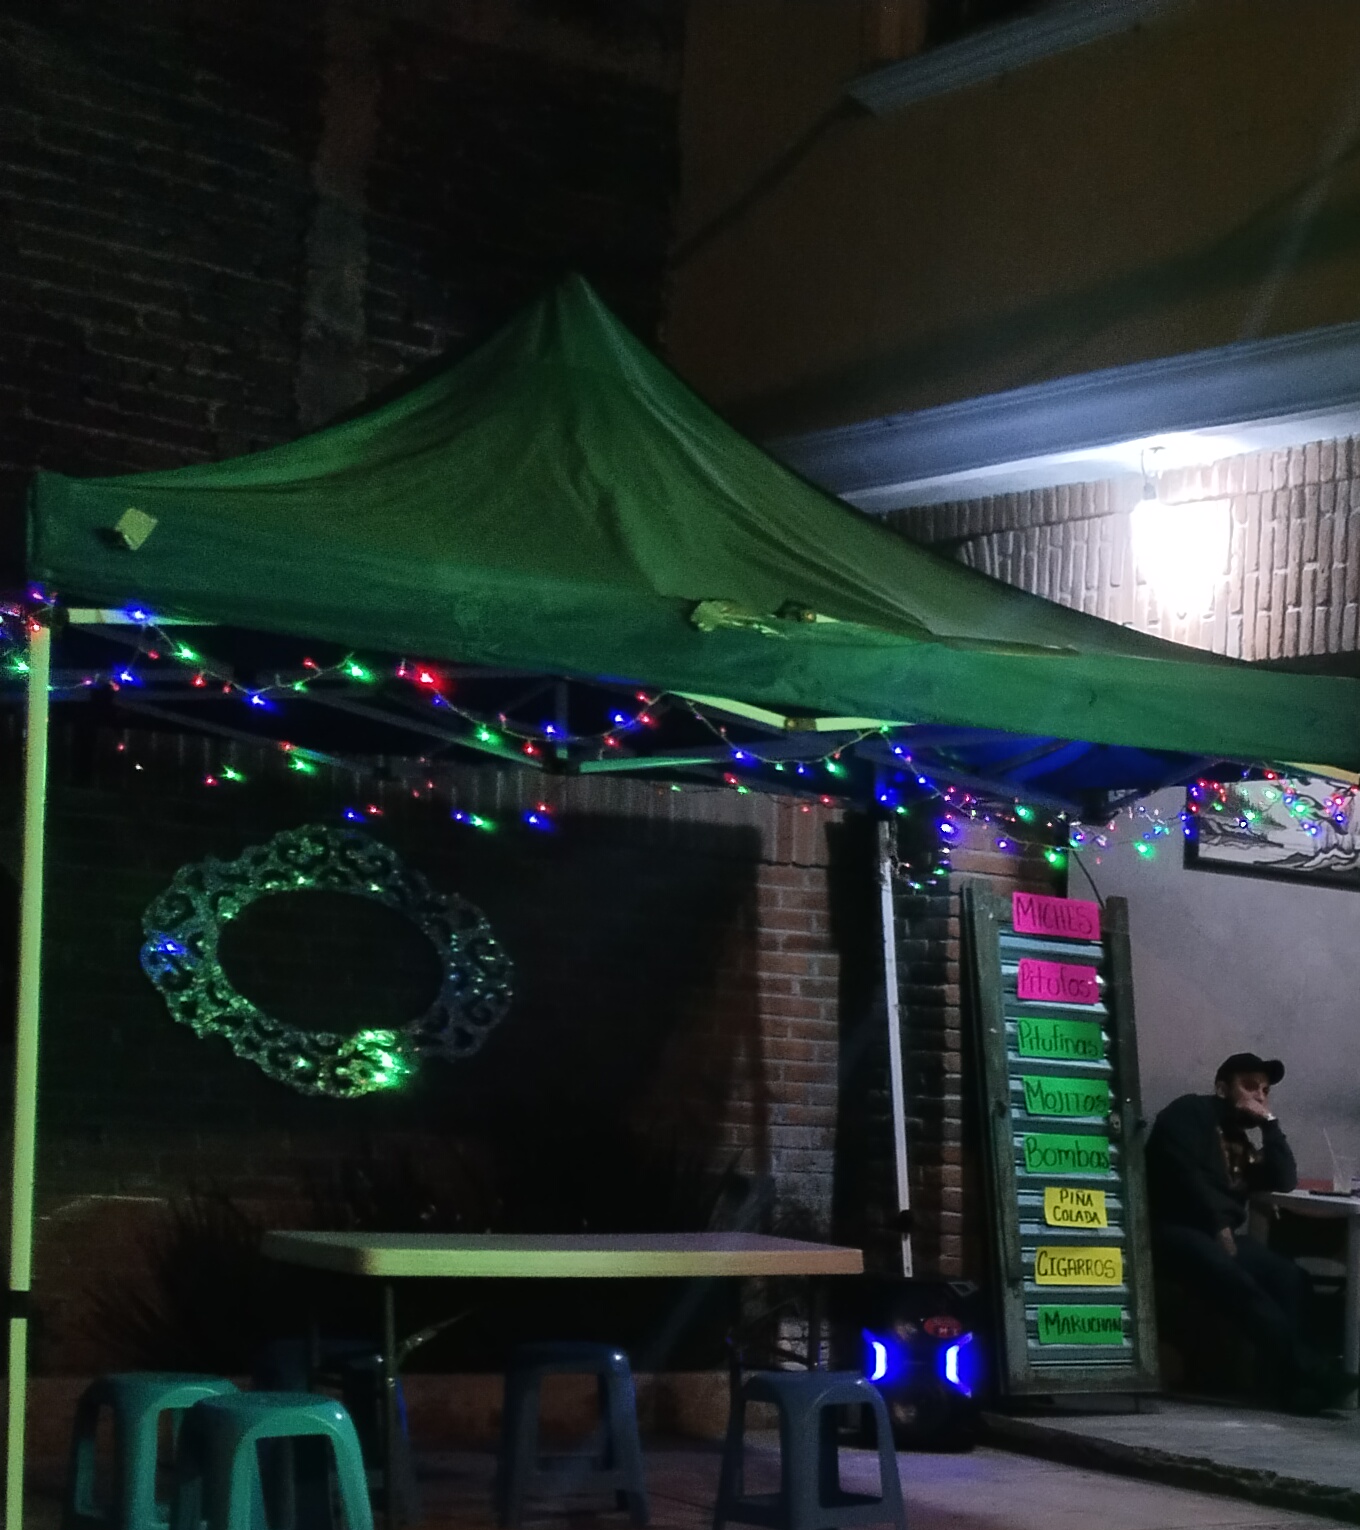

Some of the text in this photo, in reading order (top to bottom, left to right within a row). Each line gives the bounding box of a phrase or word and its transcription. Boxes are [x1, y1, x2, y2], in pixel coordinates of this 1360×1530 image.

[1025, 1136, 1109, 1169] Bombas
[1059, 1187, 1094, 1207] PIÑA
[1052, 1205, 1101, 1225] COLADA
[1036, 1250, 1116, 1279] CIGARROS
